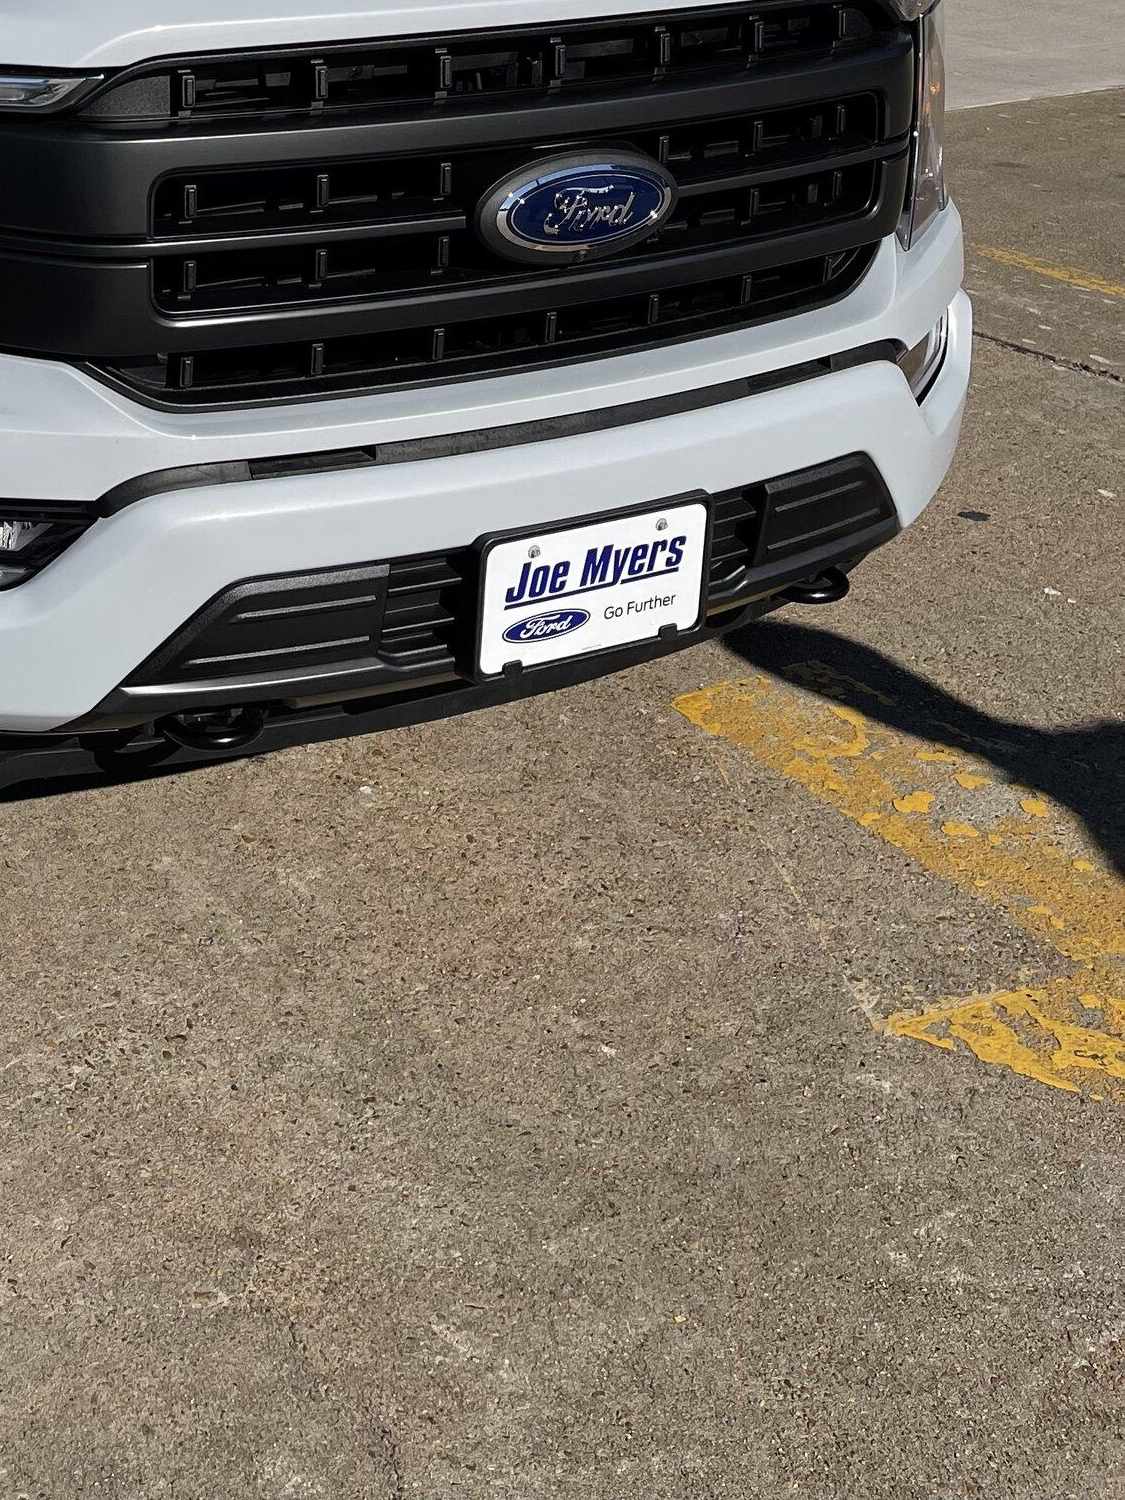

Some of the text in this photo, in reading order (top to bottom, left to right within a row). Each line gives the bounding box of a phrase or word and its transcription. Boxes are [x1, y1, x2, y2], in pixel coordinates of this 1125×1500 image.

[543, 184, 637, 235] Ford
[504, 535, 687, 603] Joe Myers
[520, 612, 573, 639] Ford
[603, 593, 677, 620] Go Further
